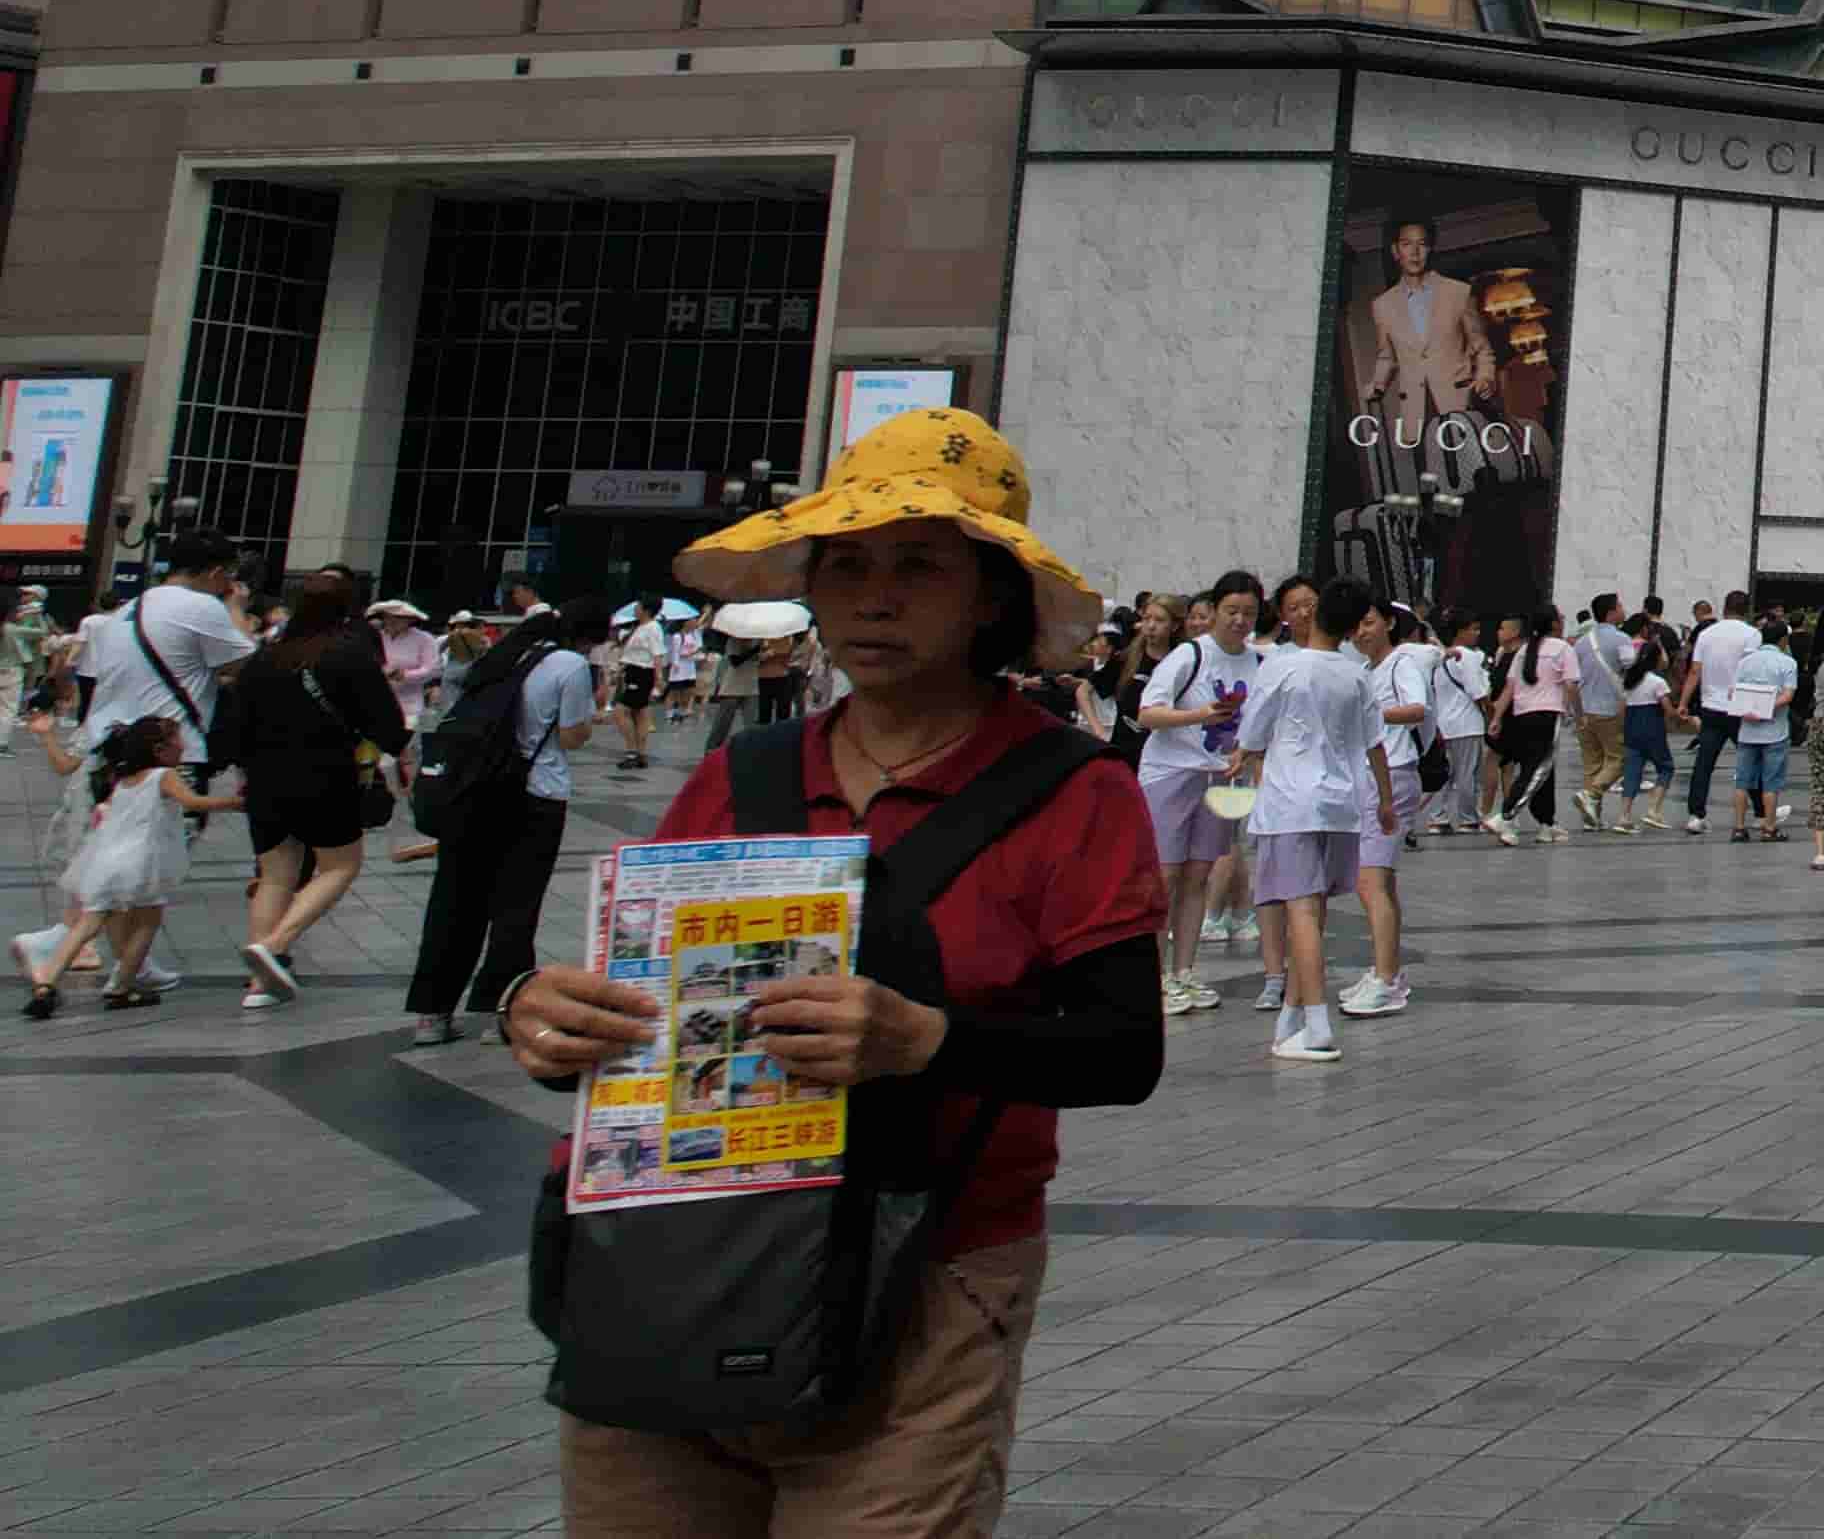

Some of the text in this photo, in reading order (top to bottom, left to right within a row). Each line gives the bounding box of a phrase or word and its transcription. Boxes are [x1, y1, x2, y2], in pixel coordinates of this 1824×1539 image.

[1629, 126, 1817, 179] GUCCI
[486, 293, 811, 334] ICBC 中国工商
[1347, 412, 1535, 457] GUCCI
[680, 899, 841, 944] 市内一日游
